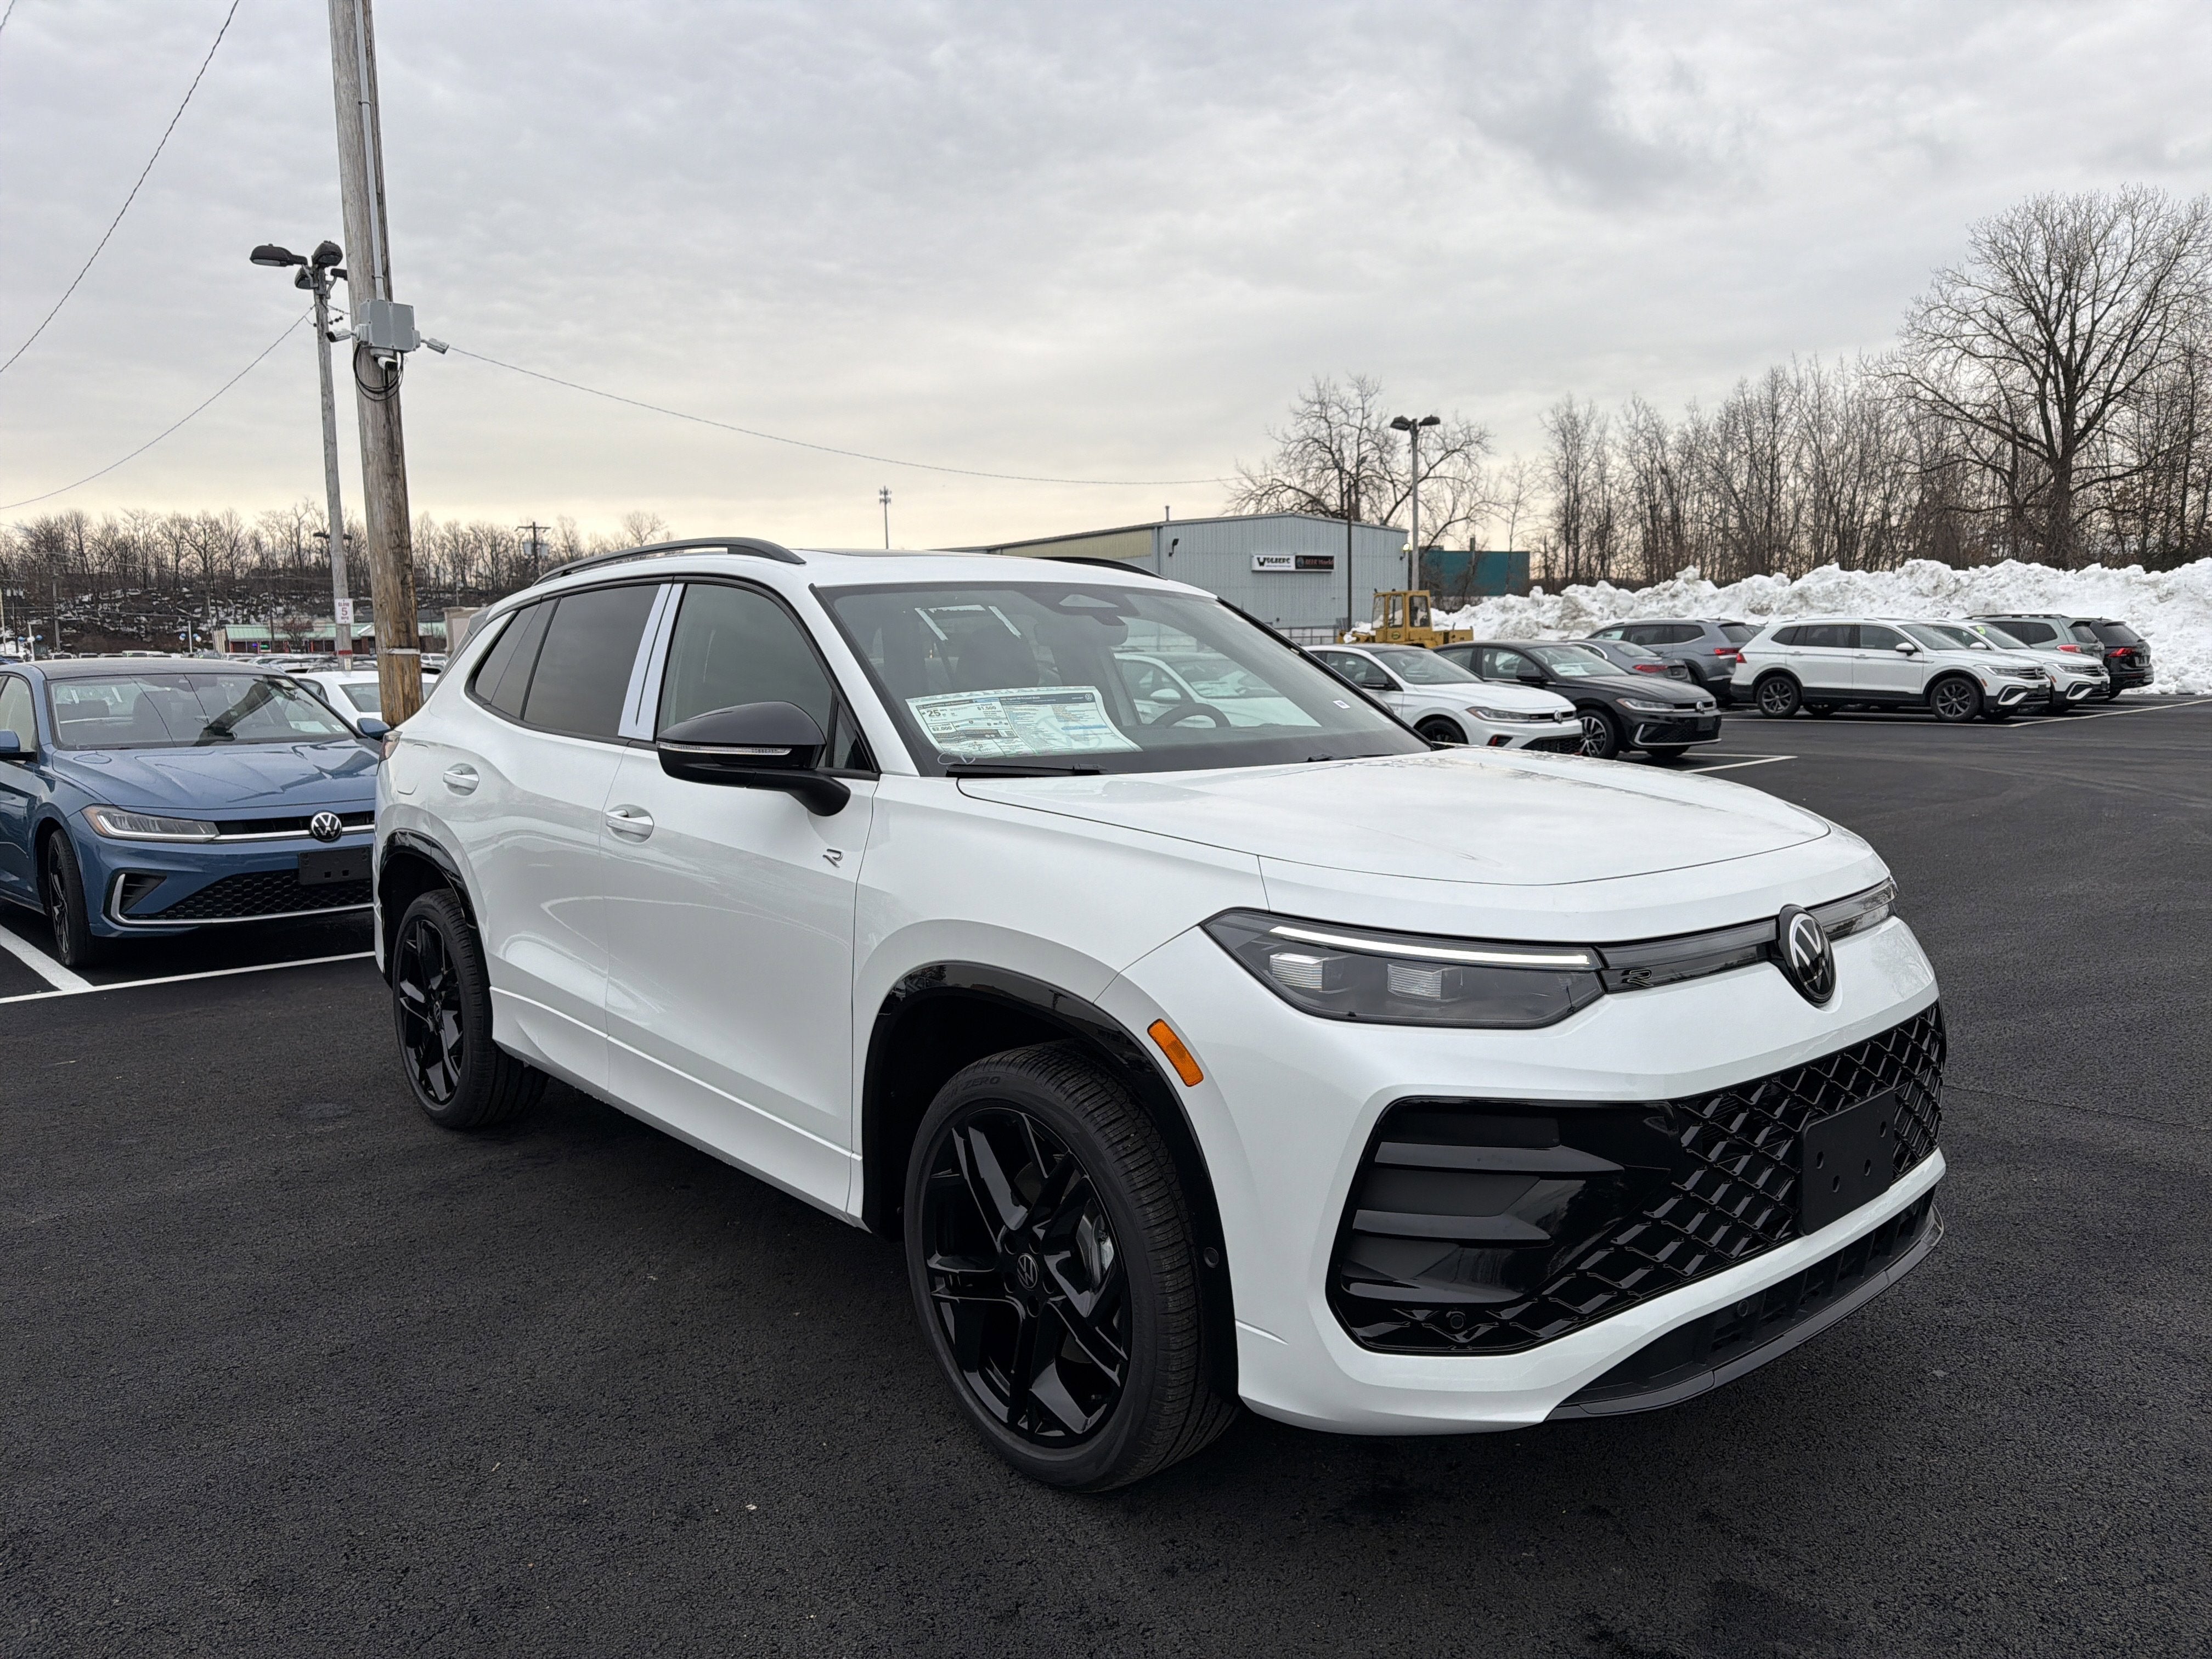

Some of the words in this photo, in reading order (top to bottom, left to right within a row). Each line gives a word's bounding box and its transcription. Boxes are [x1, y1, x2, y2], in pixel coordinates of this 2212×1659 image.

[341, 607, 348, 616] 5
[822, 848, 844, 868] R
[1627, 968, 1654, 986] R
